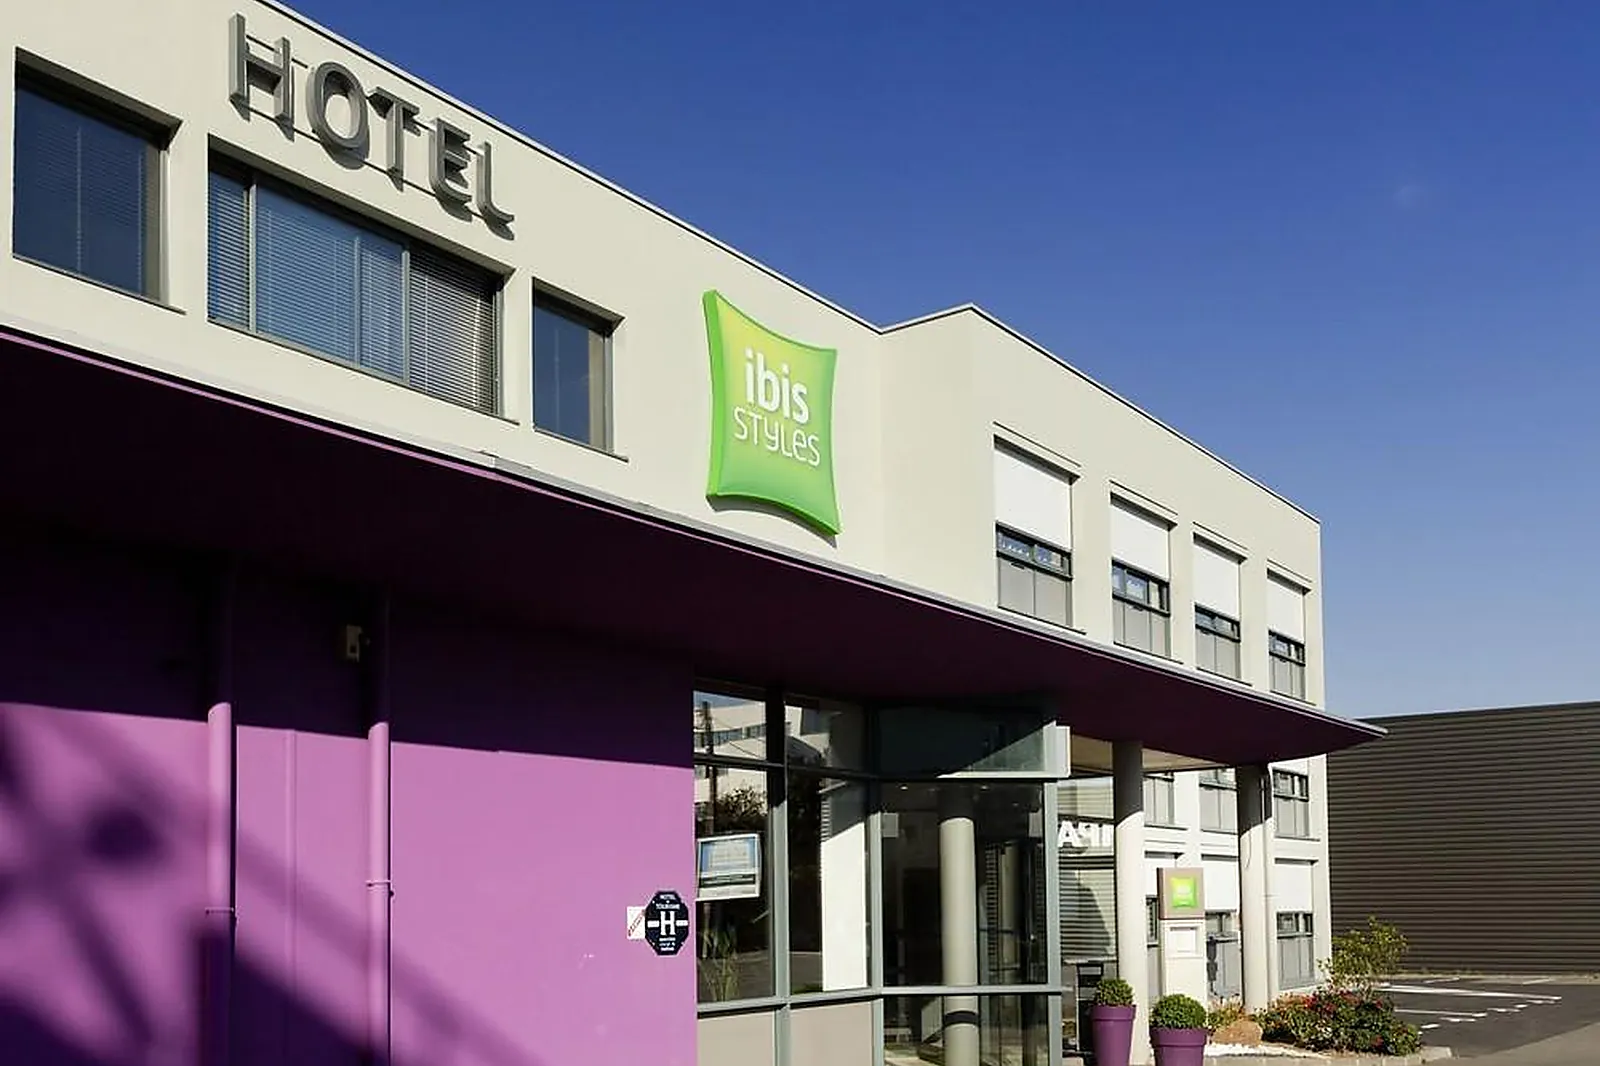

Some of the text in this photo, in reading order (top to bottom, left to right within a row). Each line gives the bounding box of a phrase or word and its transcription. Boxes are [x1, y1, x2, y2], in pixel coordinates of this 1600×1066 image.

[229, 13, 515, 230] HOTEL
[745, 347, 809, 424] ibis
[660, 910, 676, 936] H
